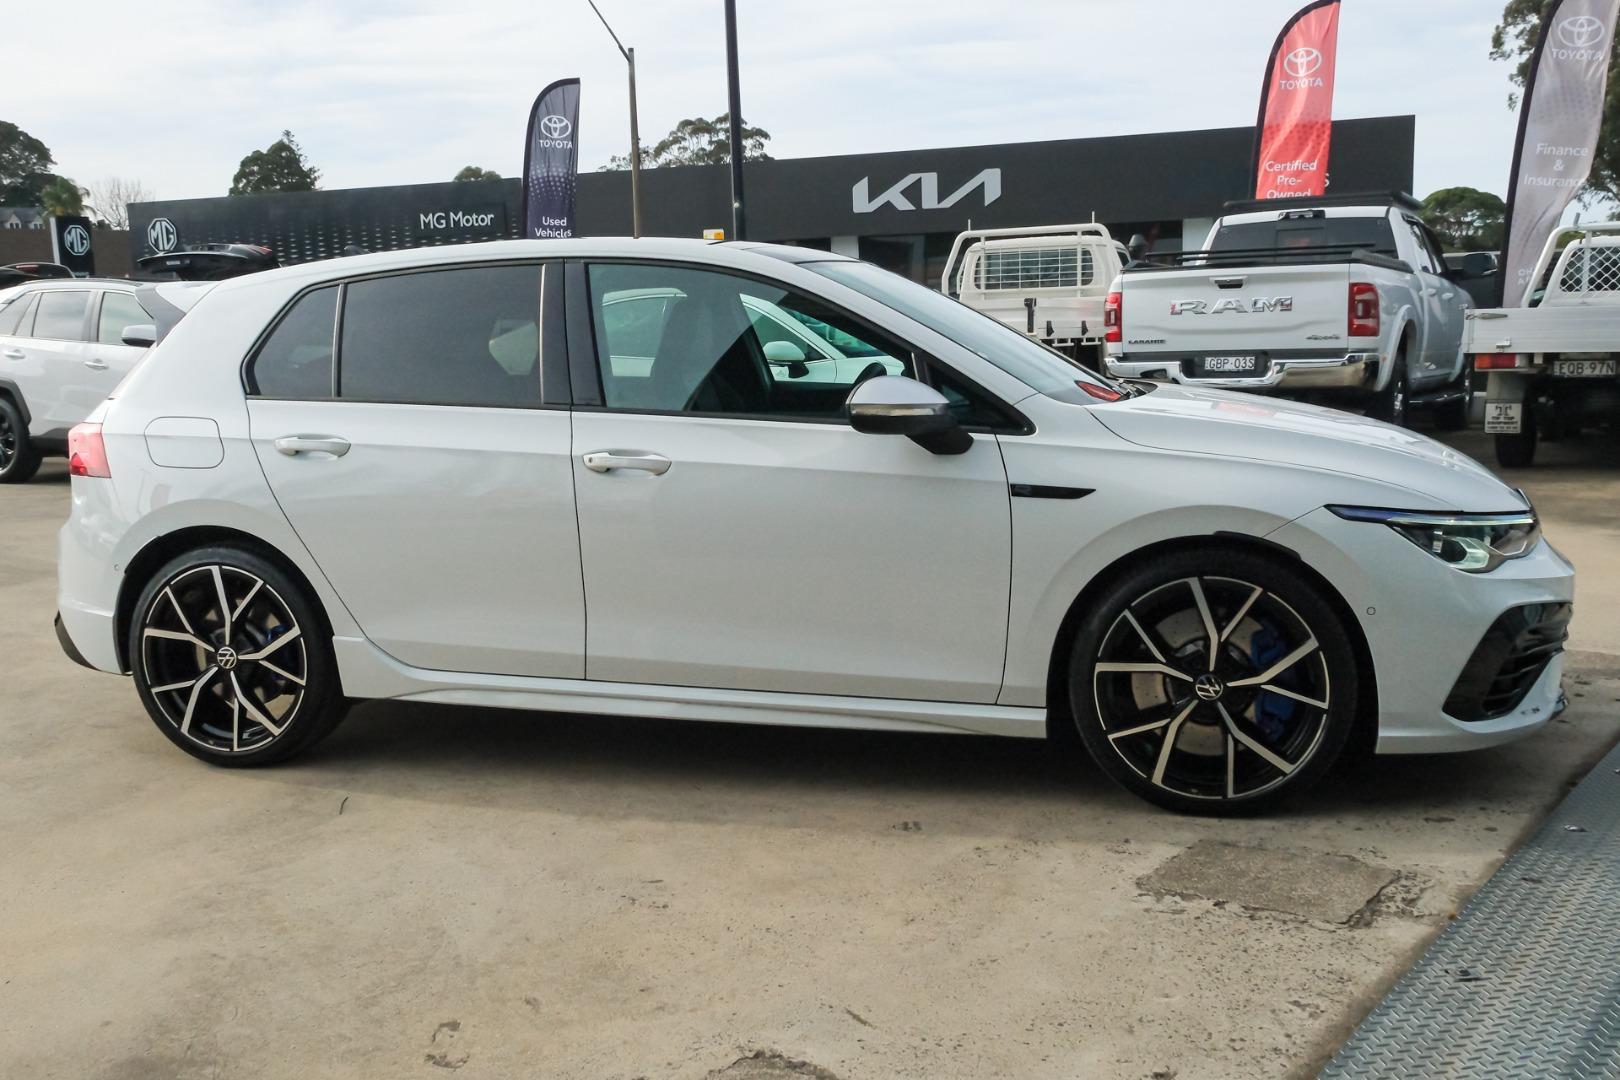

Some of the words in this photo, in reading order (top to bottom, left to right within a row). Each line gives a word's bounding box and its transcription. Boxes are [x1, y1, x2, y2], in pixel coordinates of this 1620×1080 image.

[1552, 48, 1603, 60] TOYOTA
[1280, 78, 1323, 90] TOYOTA
[539, 140, 572, 149] TOYOTA
[1535, 143, 1589, 157] Finance
[1264, 160, 1318, 172] Certified
[1553, 159, 1565, 171] &
[1277, 175, 1302, 186] Pre-
[1266, 189, 1311, 199] Owned
[420, 212, 446, 230] MG
[450, 211, 494, 227] Motor
[542, 216, 567, 226] Used
[65, 226, 90, 254] MG
[149, 219, 177, 252] MG
[1170, 296, 1293, 315] RAM
